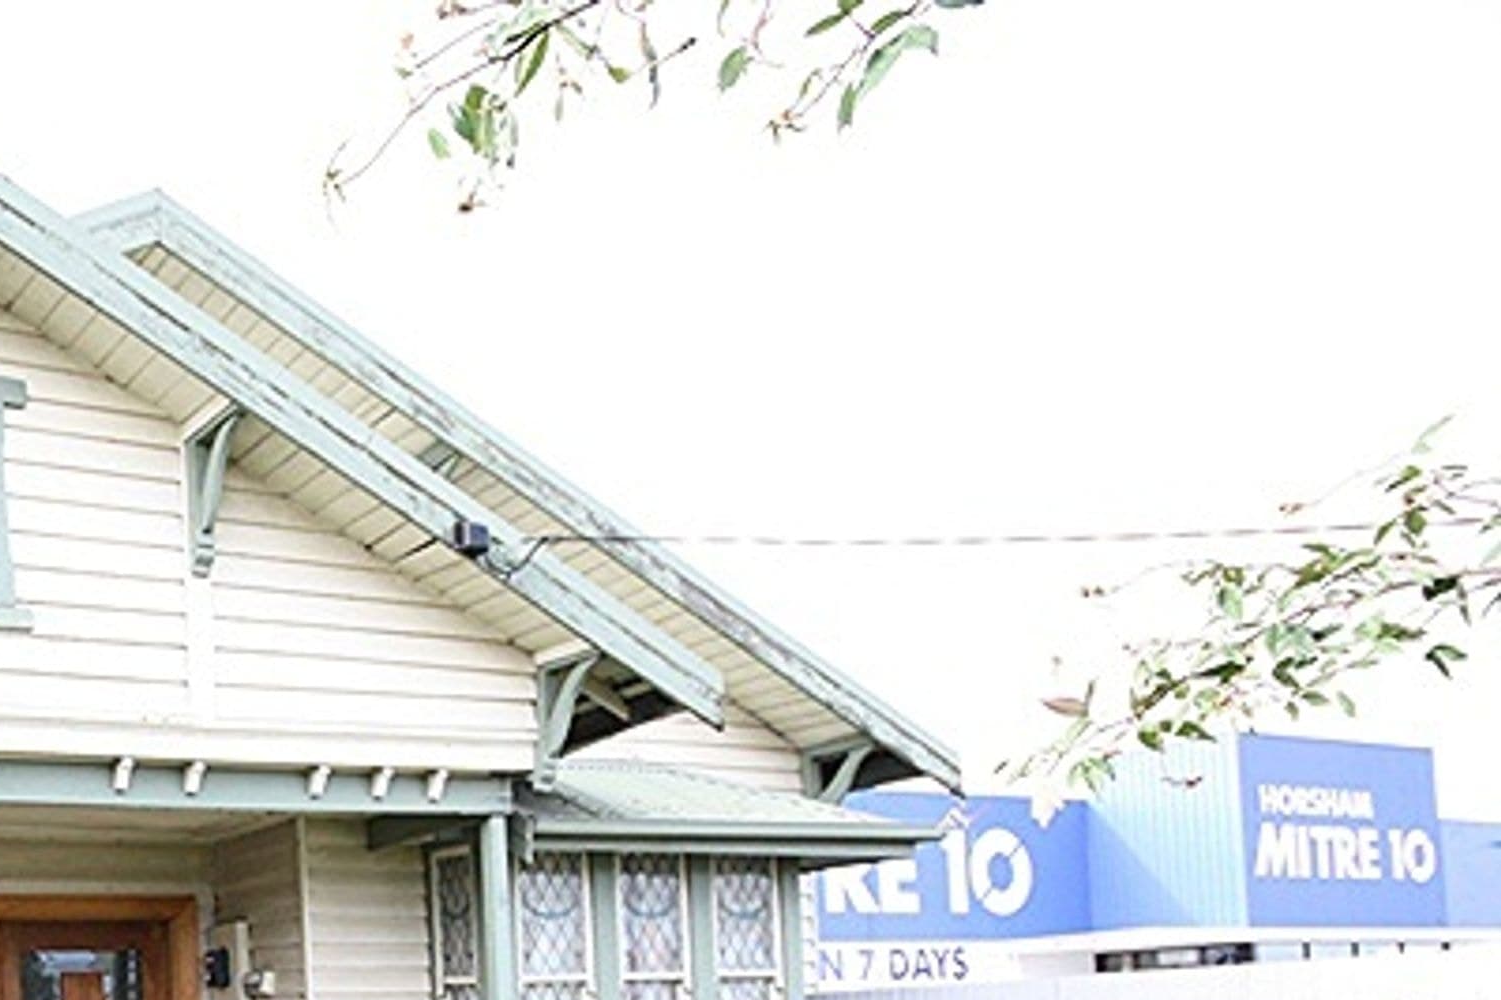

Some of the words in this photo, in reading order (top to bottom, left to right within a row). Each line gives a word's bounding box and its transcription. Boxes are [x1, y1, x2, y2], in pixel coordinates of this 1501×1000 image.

[1257, 783, 1375, 819] HORSHAM
[939, 826, 1033, 917] 10
[1253, 821, 1383, 880] MITRE
[1387, 827, 1436, 884] 10
[857, 949, 876, 980] 7
[888, 946, 970, 981] DAYS
